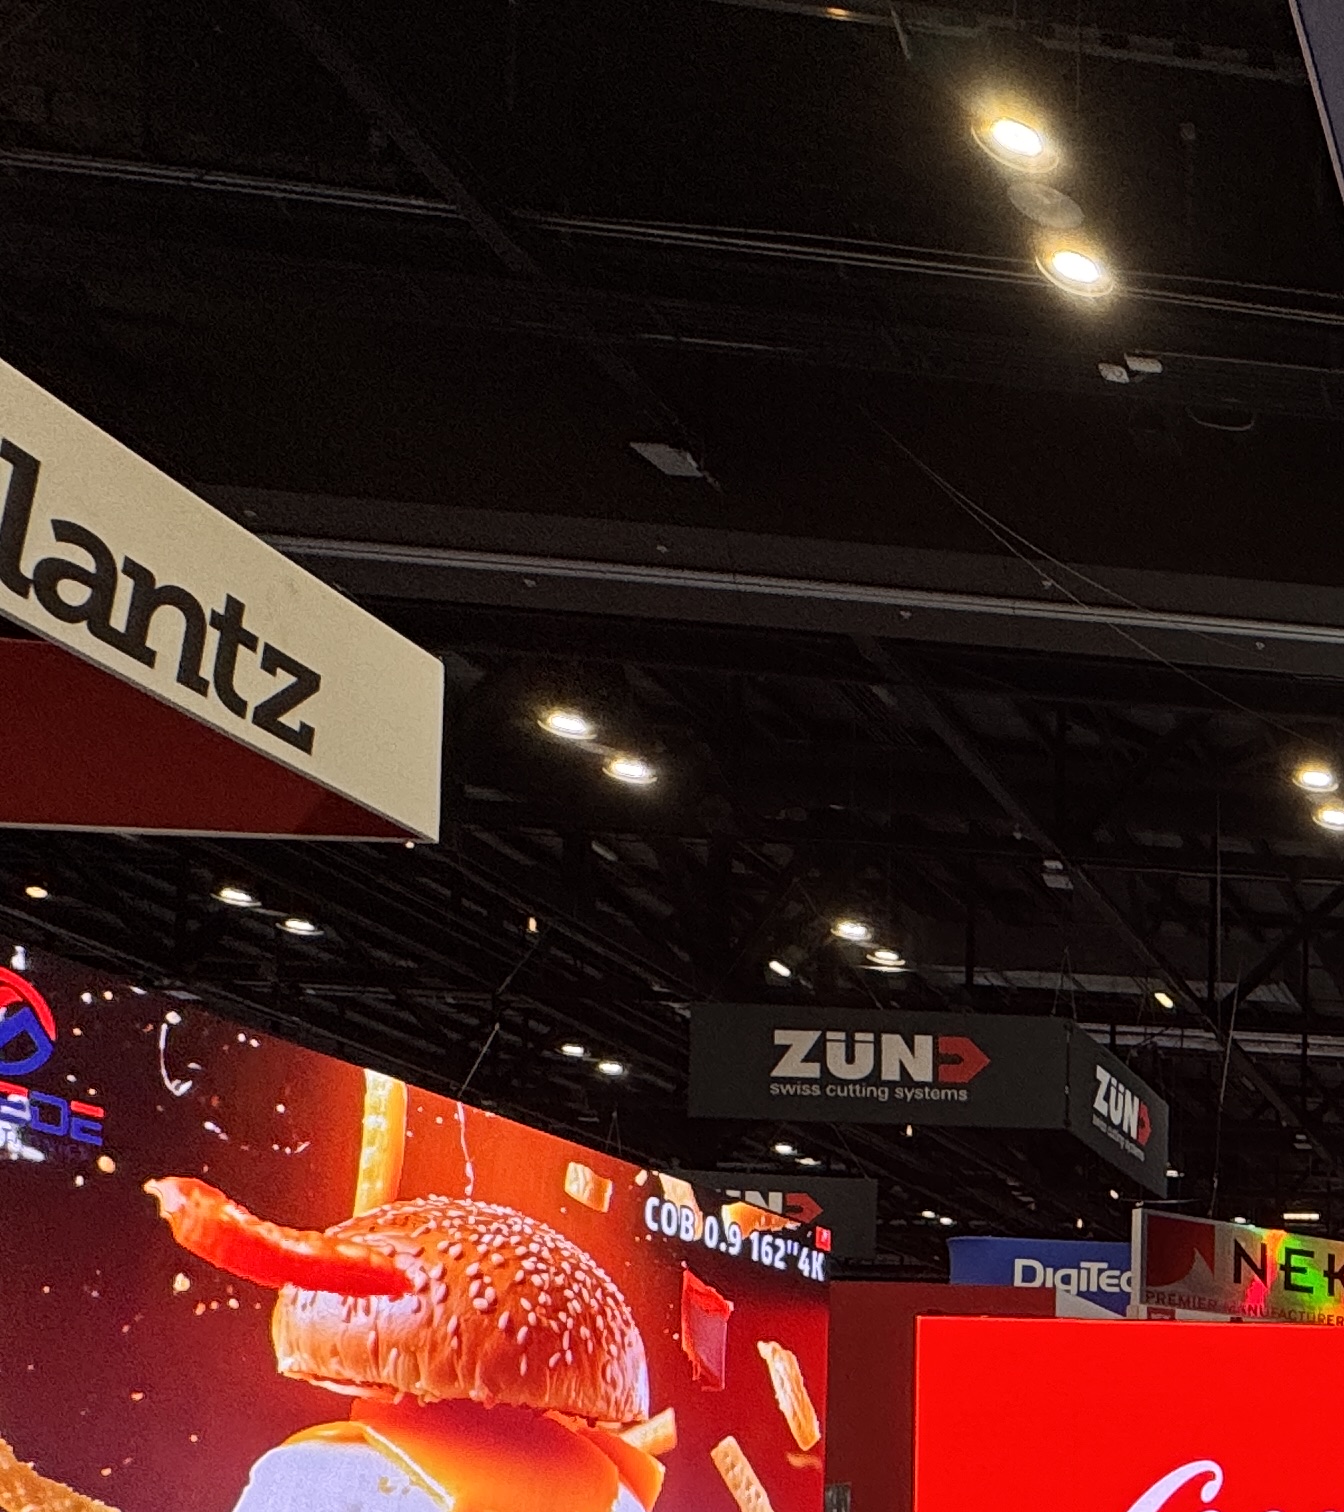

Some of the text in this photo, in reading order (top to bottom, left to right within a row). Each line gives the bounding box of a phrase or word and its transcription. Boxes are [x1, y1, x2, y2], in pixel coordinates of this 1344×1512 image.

[0, 437, 322, 756] lantz
[769, 1082, 968, 1101] swiss cutting systems
[644, 1196, 696, 1242] COB
[704, 1214, 743, 1256] 0.9
